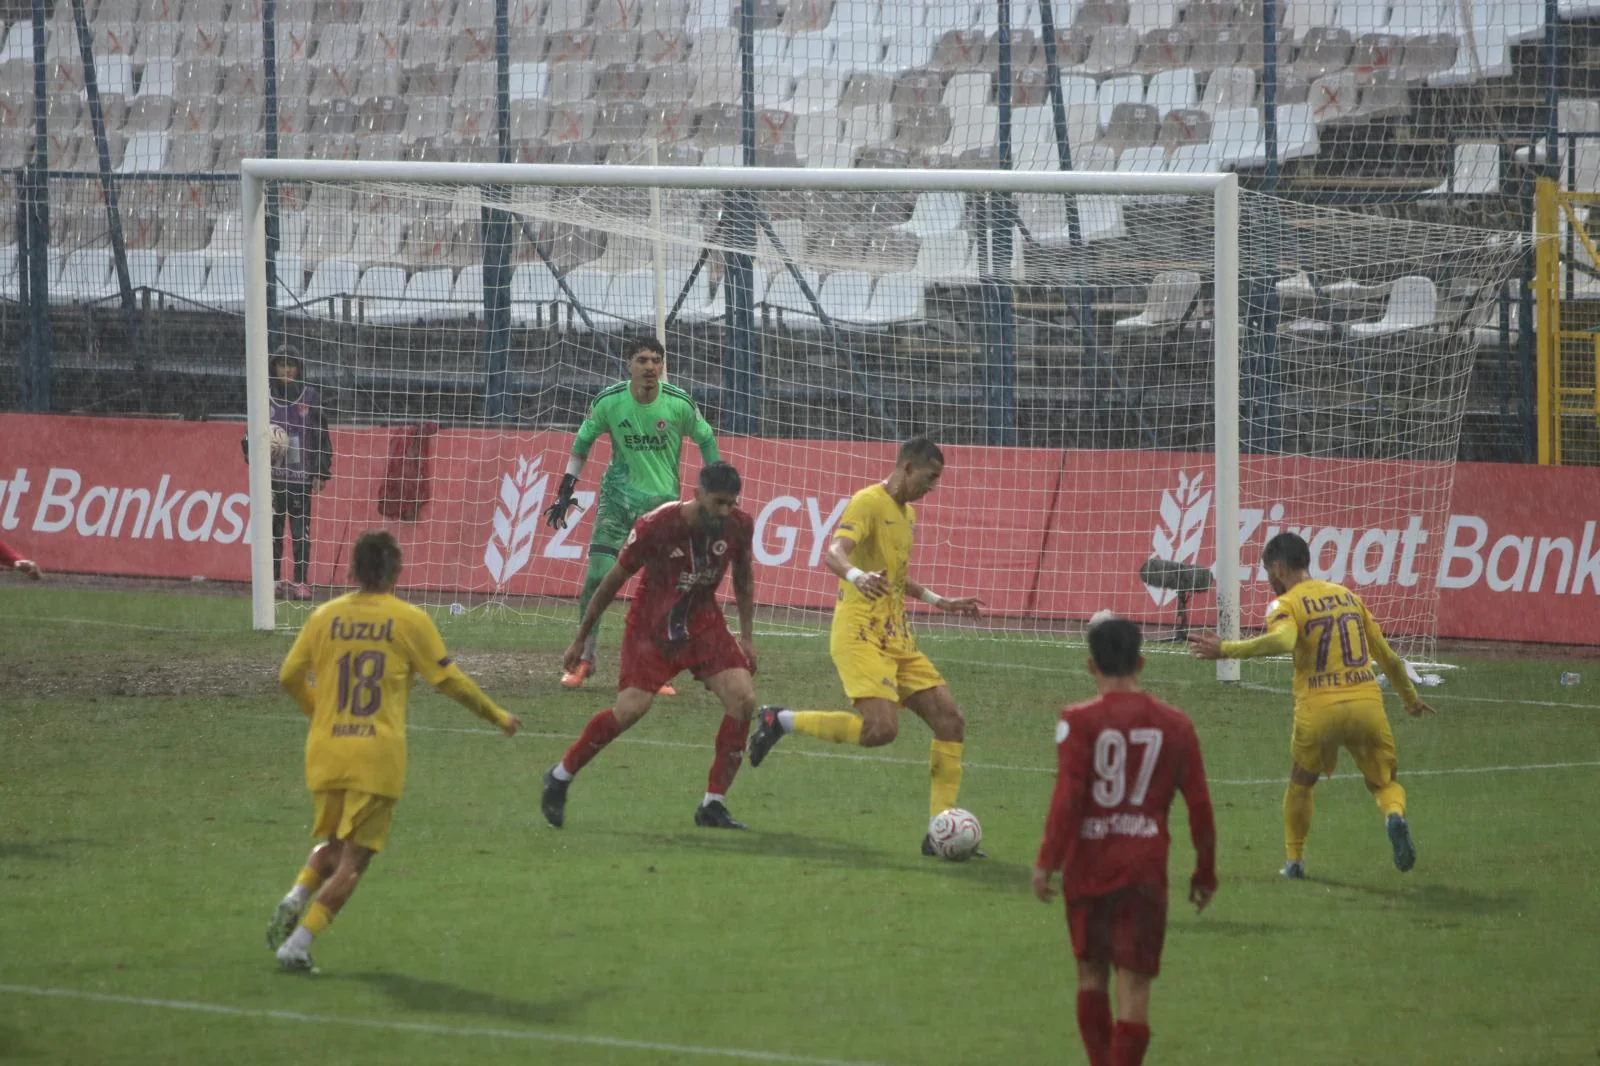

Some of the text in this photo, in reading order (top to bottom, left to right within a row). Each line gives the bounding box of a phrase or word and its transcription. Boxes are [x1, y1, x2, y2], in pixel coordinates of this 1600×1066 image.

[1304, 612, 1368, 672] 70
[337, 651, 386, 717] 18
[1307, 673, 1340, 689] METE
[1092, 728, 1164, 808] 97
